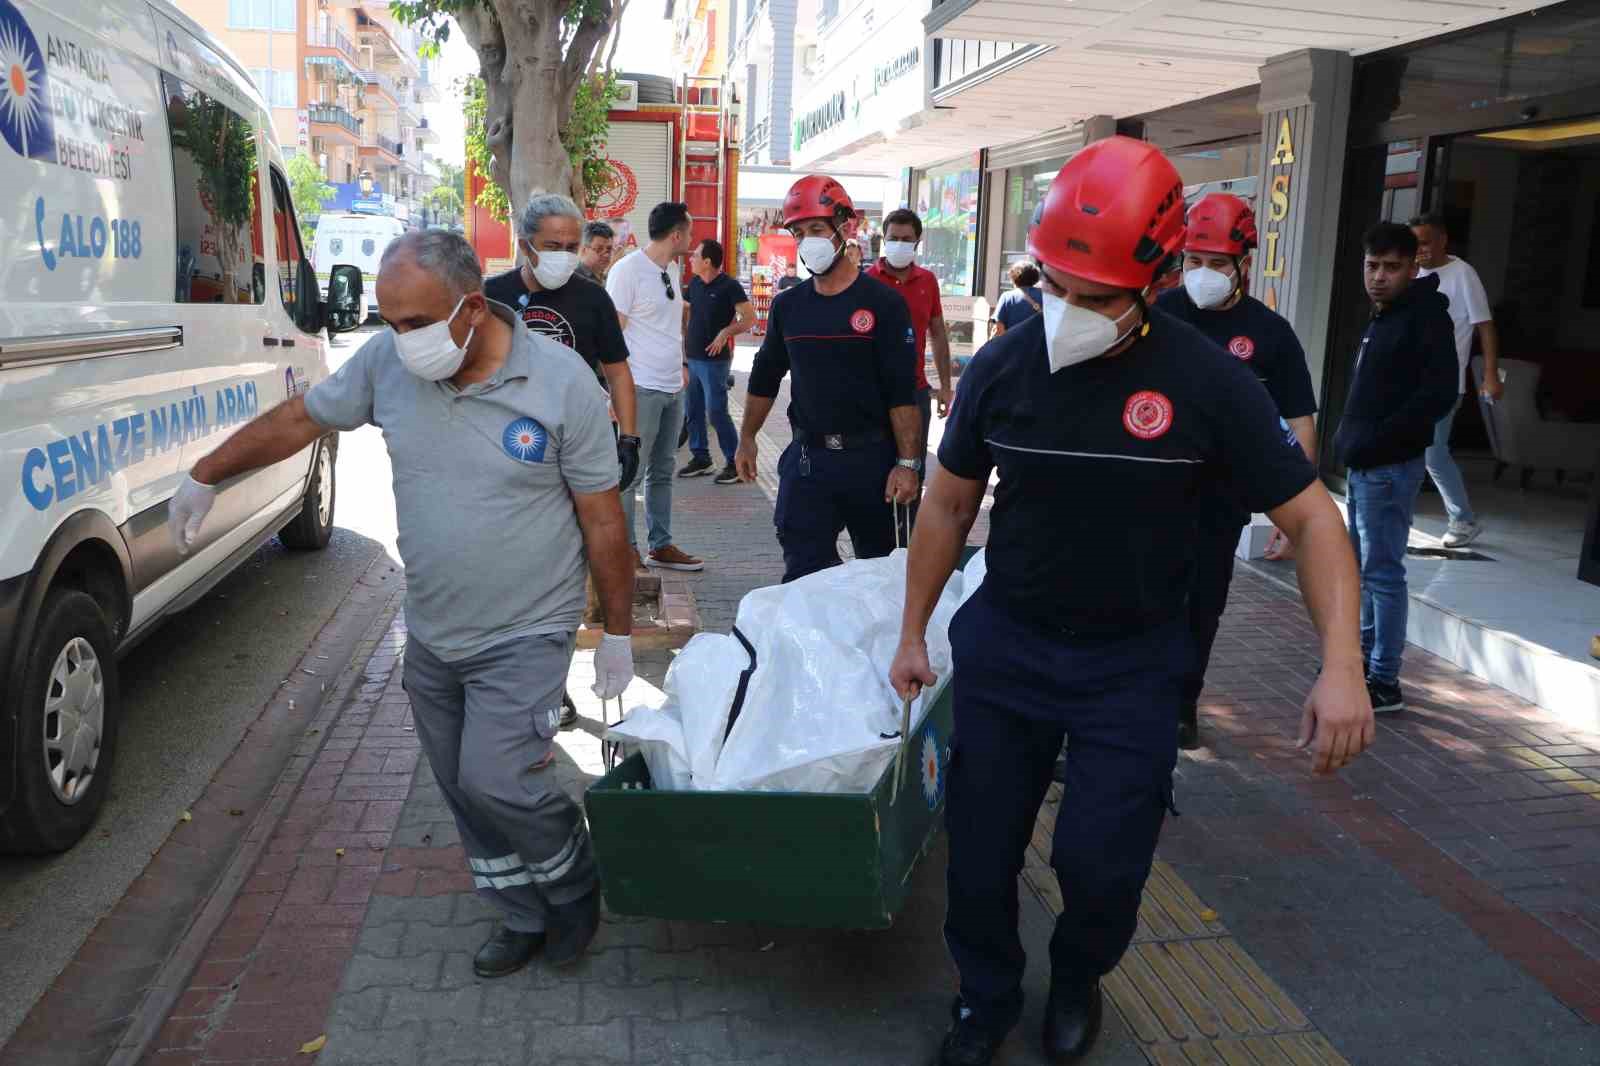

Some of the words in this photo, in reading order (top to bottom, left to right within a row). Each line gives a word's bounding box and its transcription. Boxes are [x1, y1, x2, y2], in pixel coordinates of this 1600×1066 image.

[58, 213, 107, 258] ALO
[111, 218, 142, 258] 188
[22, 412, 145, 511] CENAZE
[150, 385, 208, 456] NAKİL
[214, 381, 258, 432] ARACI
